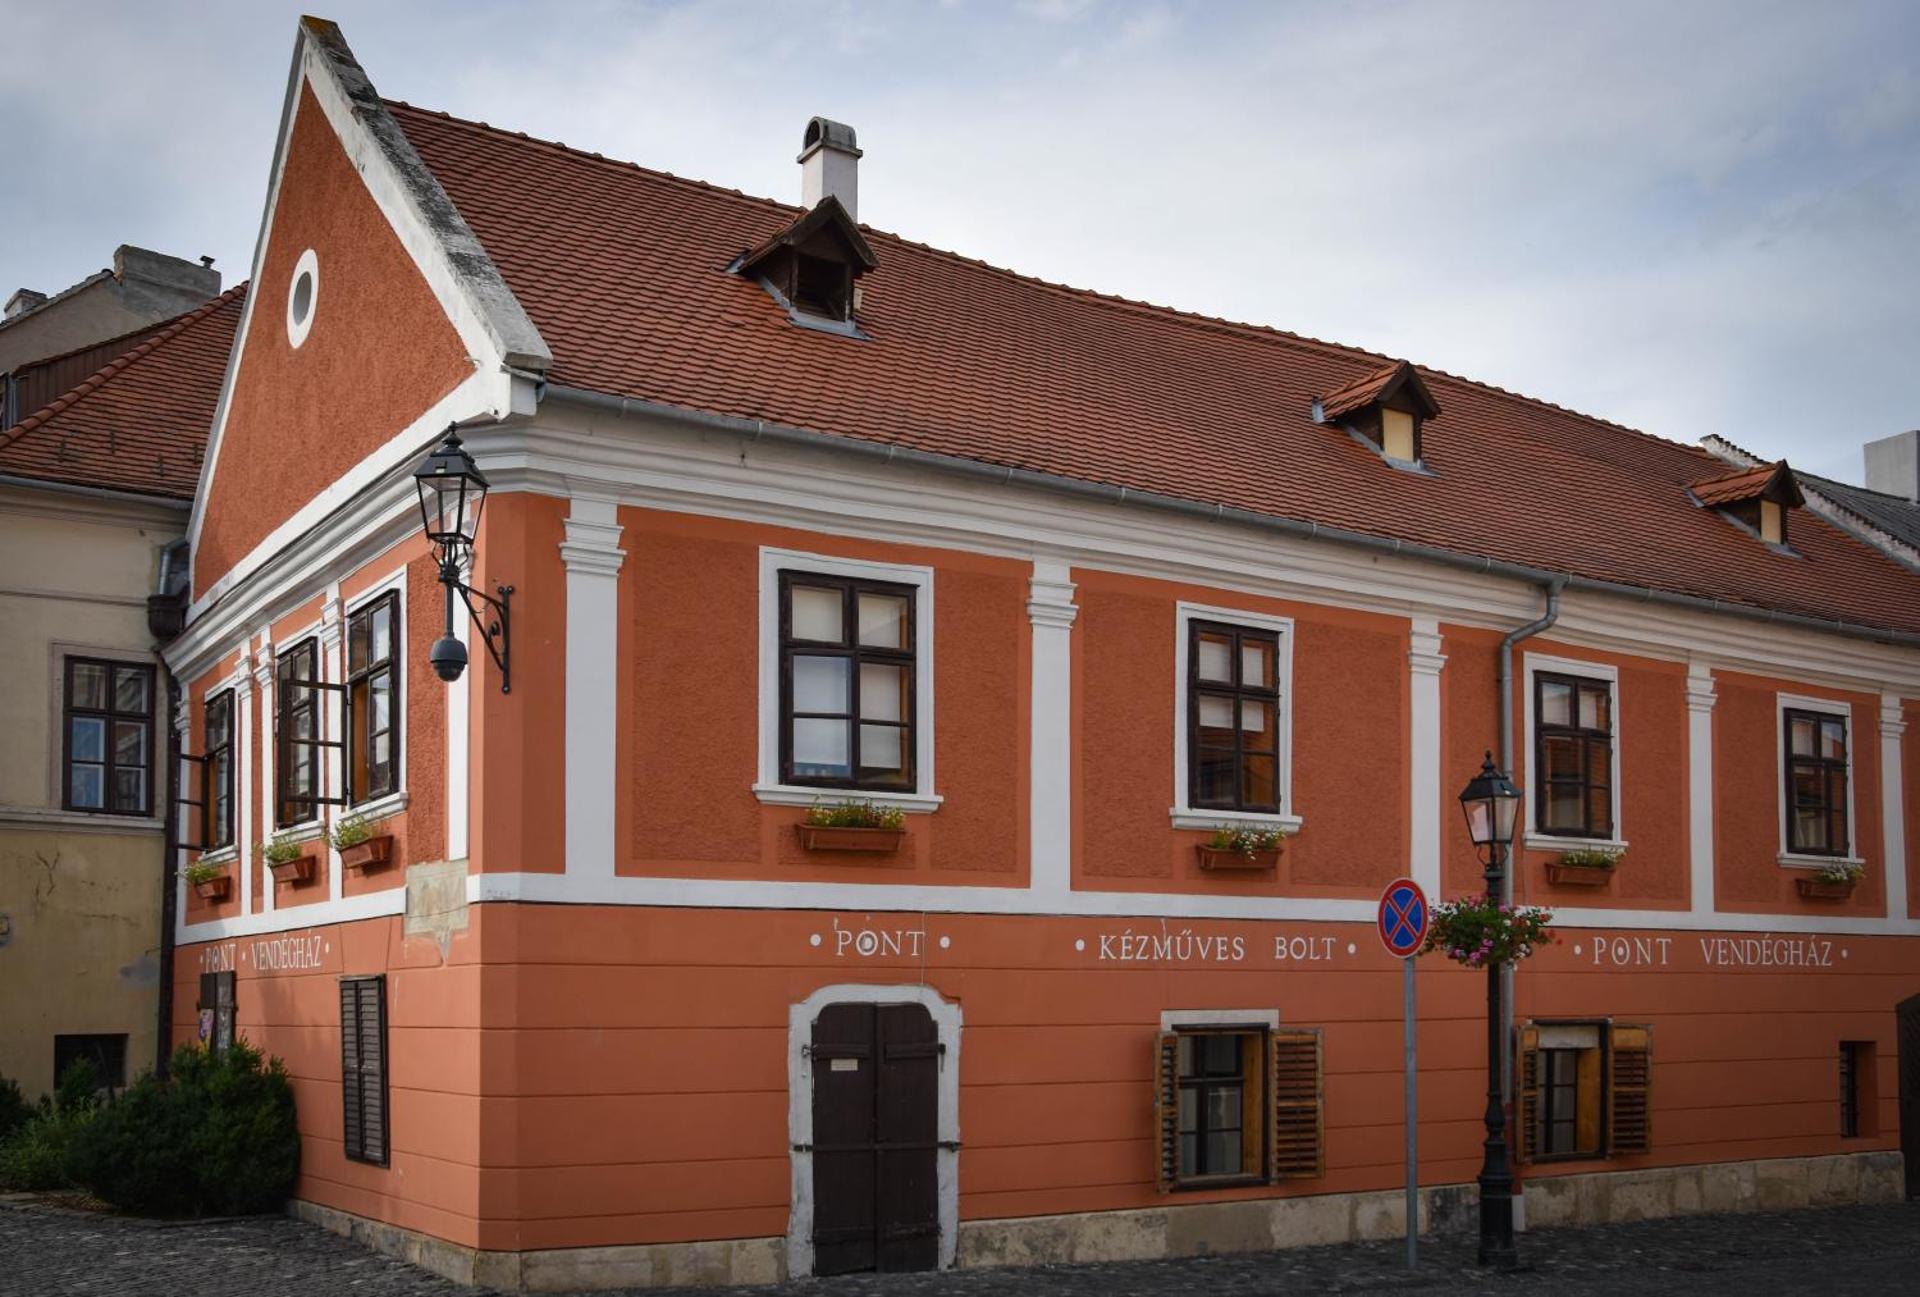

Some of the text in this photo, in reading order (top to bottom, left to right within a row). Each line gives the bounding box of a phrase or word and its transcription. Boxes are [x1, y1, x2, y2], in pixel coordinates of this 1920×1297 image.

[205, 930, 322, 973] PONT VENDÉGHÁZ
[835, 930, 926, 956] PONT
[1099, 928, 1336, 960] KÉZMŰVES BOLT
[1593, 933, 1832, 966] PONT VENDÉGHÁZ
